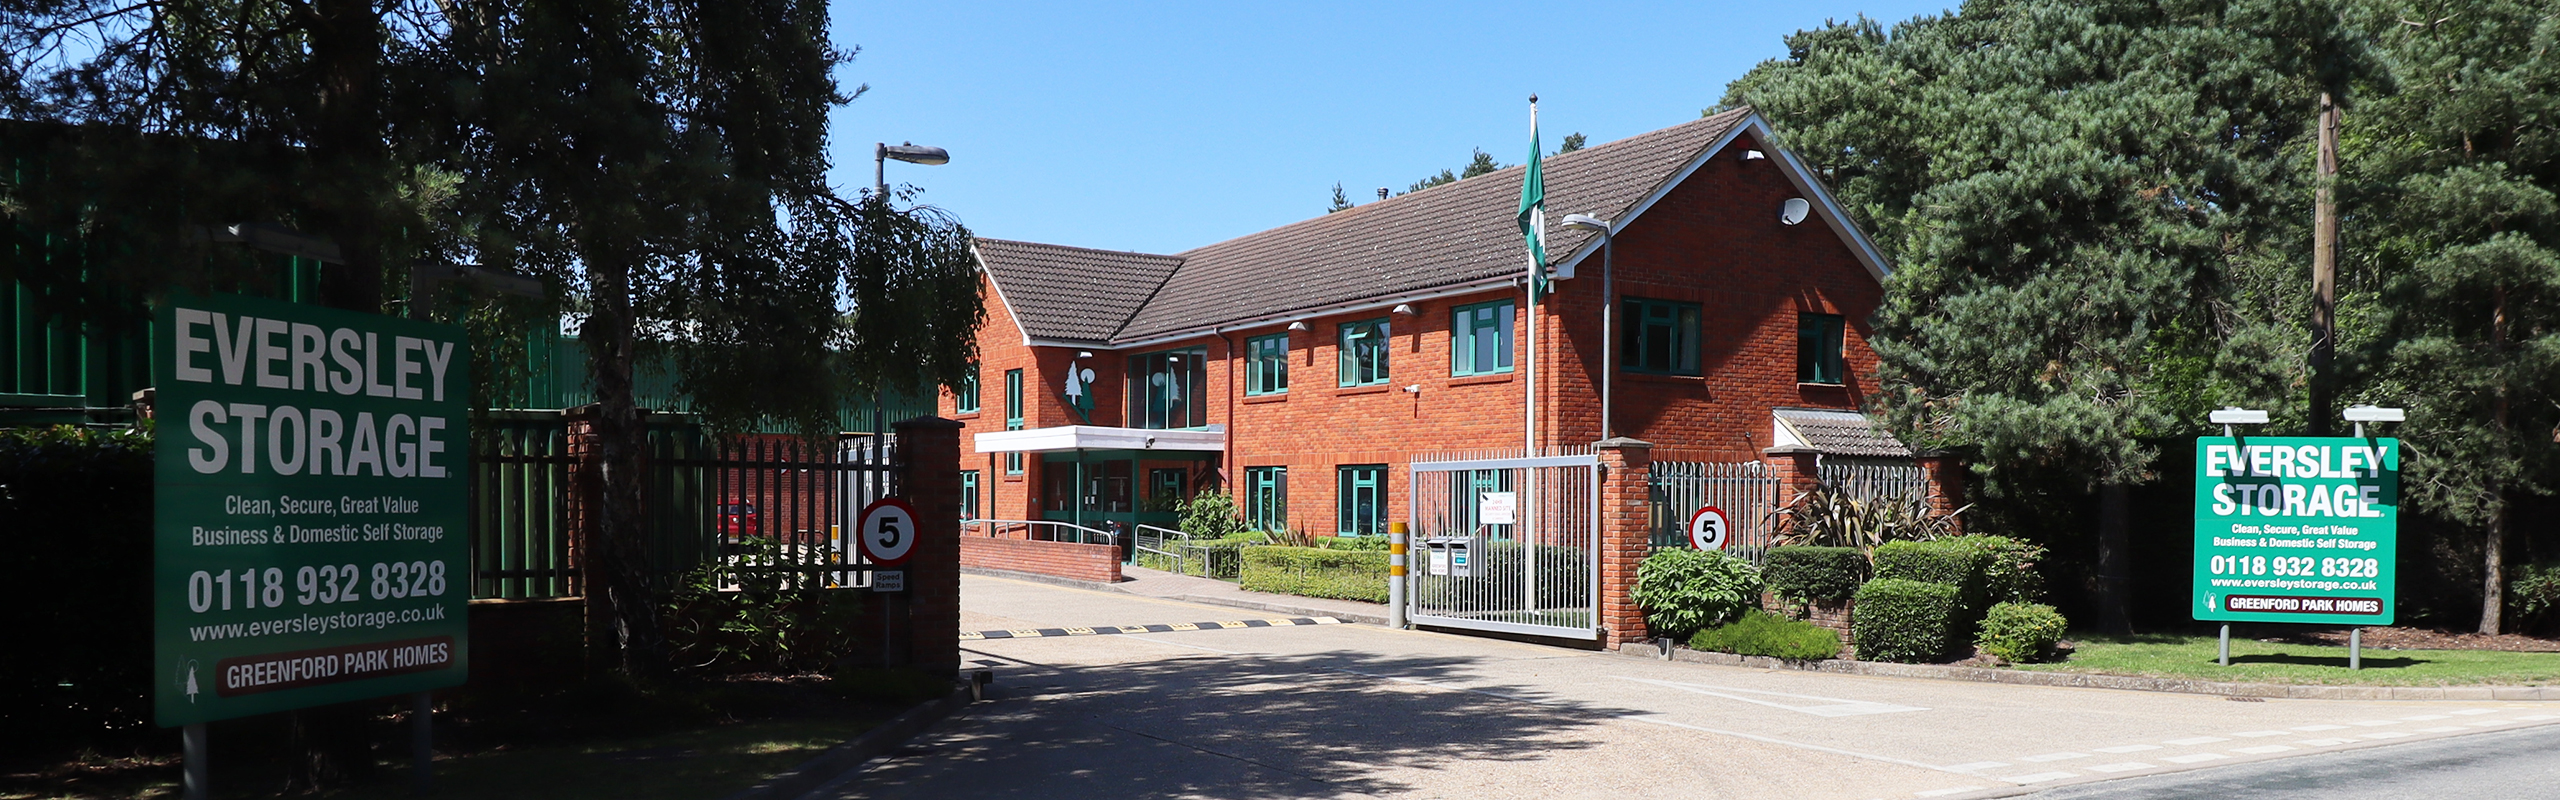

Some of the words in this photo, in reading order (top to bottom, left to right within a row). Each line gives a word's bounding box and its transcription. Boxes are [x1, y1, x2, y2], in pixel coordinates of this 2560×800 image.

[175, 307, 454, 402] EVERSLEY
[188, 400, 446, 478] STORAGE
[2206, 445, 2388, 478] EVERSLEY
[225, 496, 275, 518] Clean,
[280, 496, 336, 516] Secure,
[340, 496, 379, 514] Great
[382, 496, 419, 514] Value
[2212, 484, 2380, 517] STORAGE
[192, 525, 268, 546] Business
[273, 526, 285, 544] &
[290, 525, 359, 544] Domestic
[363, 524, 390, 541] Self
[393, 524, 443, 543] Storage
[878, 517, 900, 548] 5
[1703, 520, 1716, 543] 5
[2213, 537, 2257, 547] Business
[2259, 538, 2267, 547] &
[2269, 538, 2314, 548] Domestic
[2316, 538, 2336, 548] Self
[2338, 539, 2376, 550] Storage
[2232, 524, 2261, 536] Clean,
[2264, 524, 2299, 536] Secure,
[2302, 525, 2329, 535] Great
[2331, 525, 2358, 536] Value
[2210, 555, 2266, 575] 0118
[2272, 556, 2315, 576] 932
[2321, 557, 2378, 578] 8328
[188, 567, 284, 613] 0118
[297, 564, 359, 605] 932
[371, 560, 446, 600] 8328
[2211, 578, 2376, 591] www.eversleystorage.co.uk
[2230, 598, 2299, 610] GREENFORD
[2302, 600, 2333, 611] PARK
[2336, 600, 2378, 612] HOMES
[190, 604, 445, 642] www.eversleystorage.co.uk
[226, 656, 339, 690] GREENFORD
[345, 649, 388, 674] PARK
[393, 643, 448, 668] HOMES
